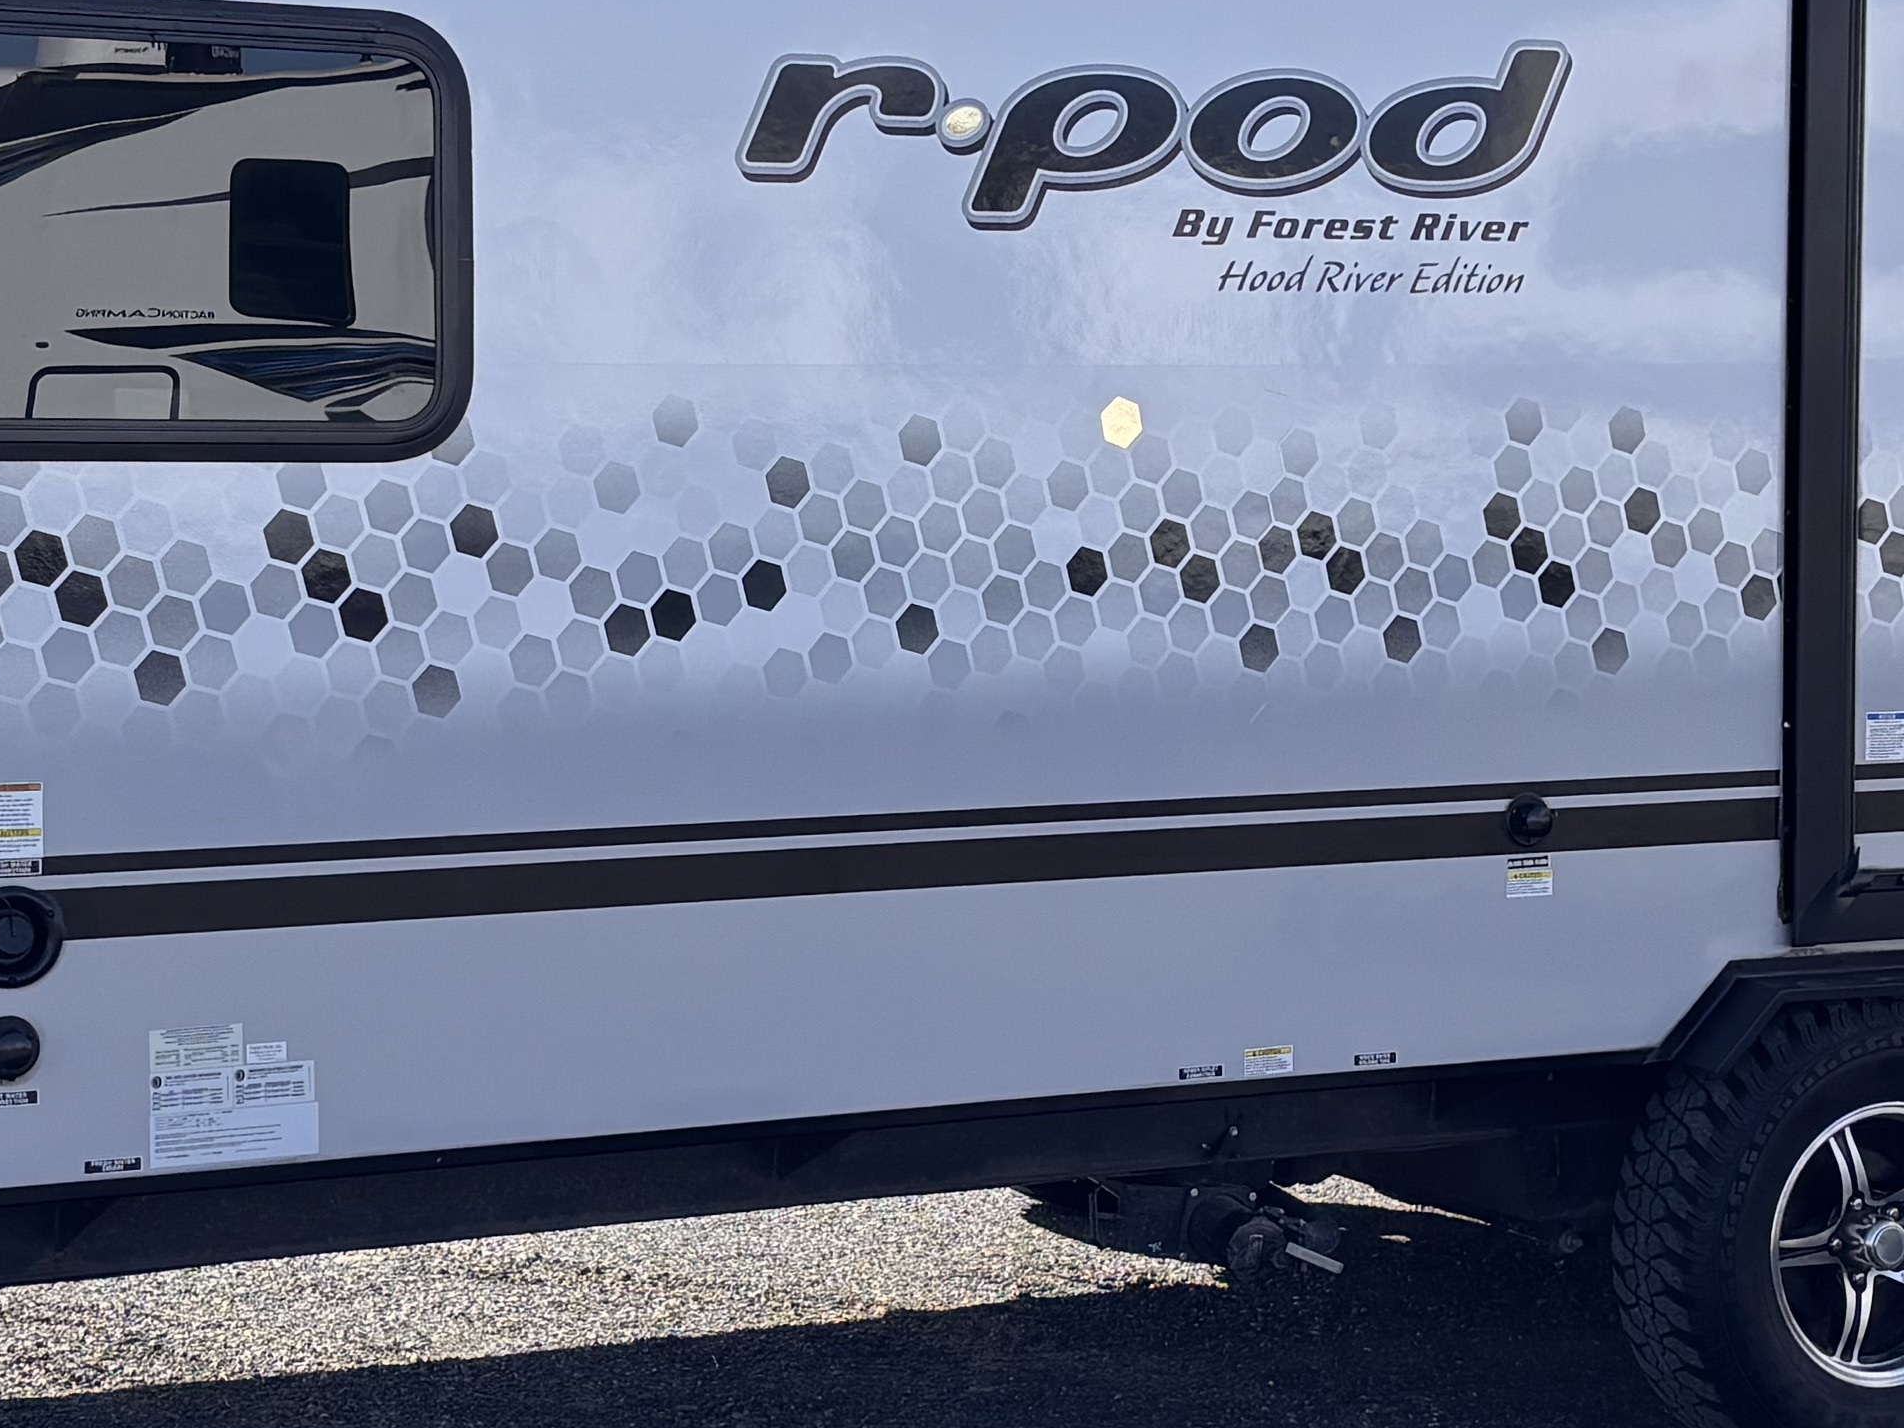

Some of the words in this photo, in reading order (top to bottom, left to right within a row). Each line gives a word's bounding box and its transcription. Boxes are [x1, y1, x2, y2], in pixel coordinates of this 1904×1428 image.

[1173, 209, 1231, 245] By
[1247, 210, 1400, 243] Forest
[1410, 213, 1530, 243] River
[1218, 255, 1314, 293] Hood
[1317, 260, 1403, 295] River
[1408, 258, 1525, 296] Edition
